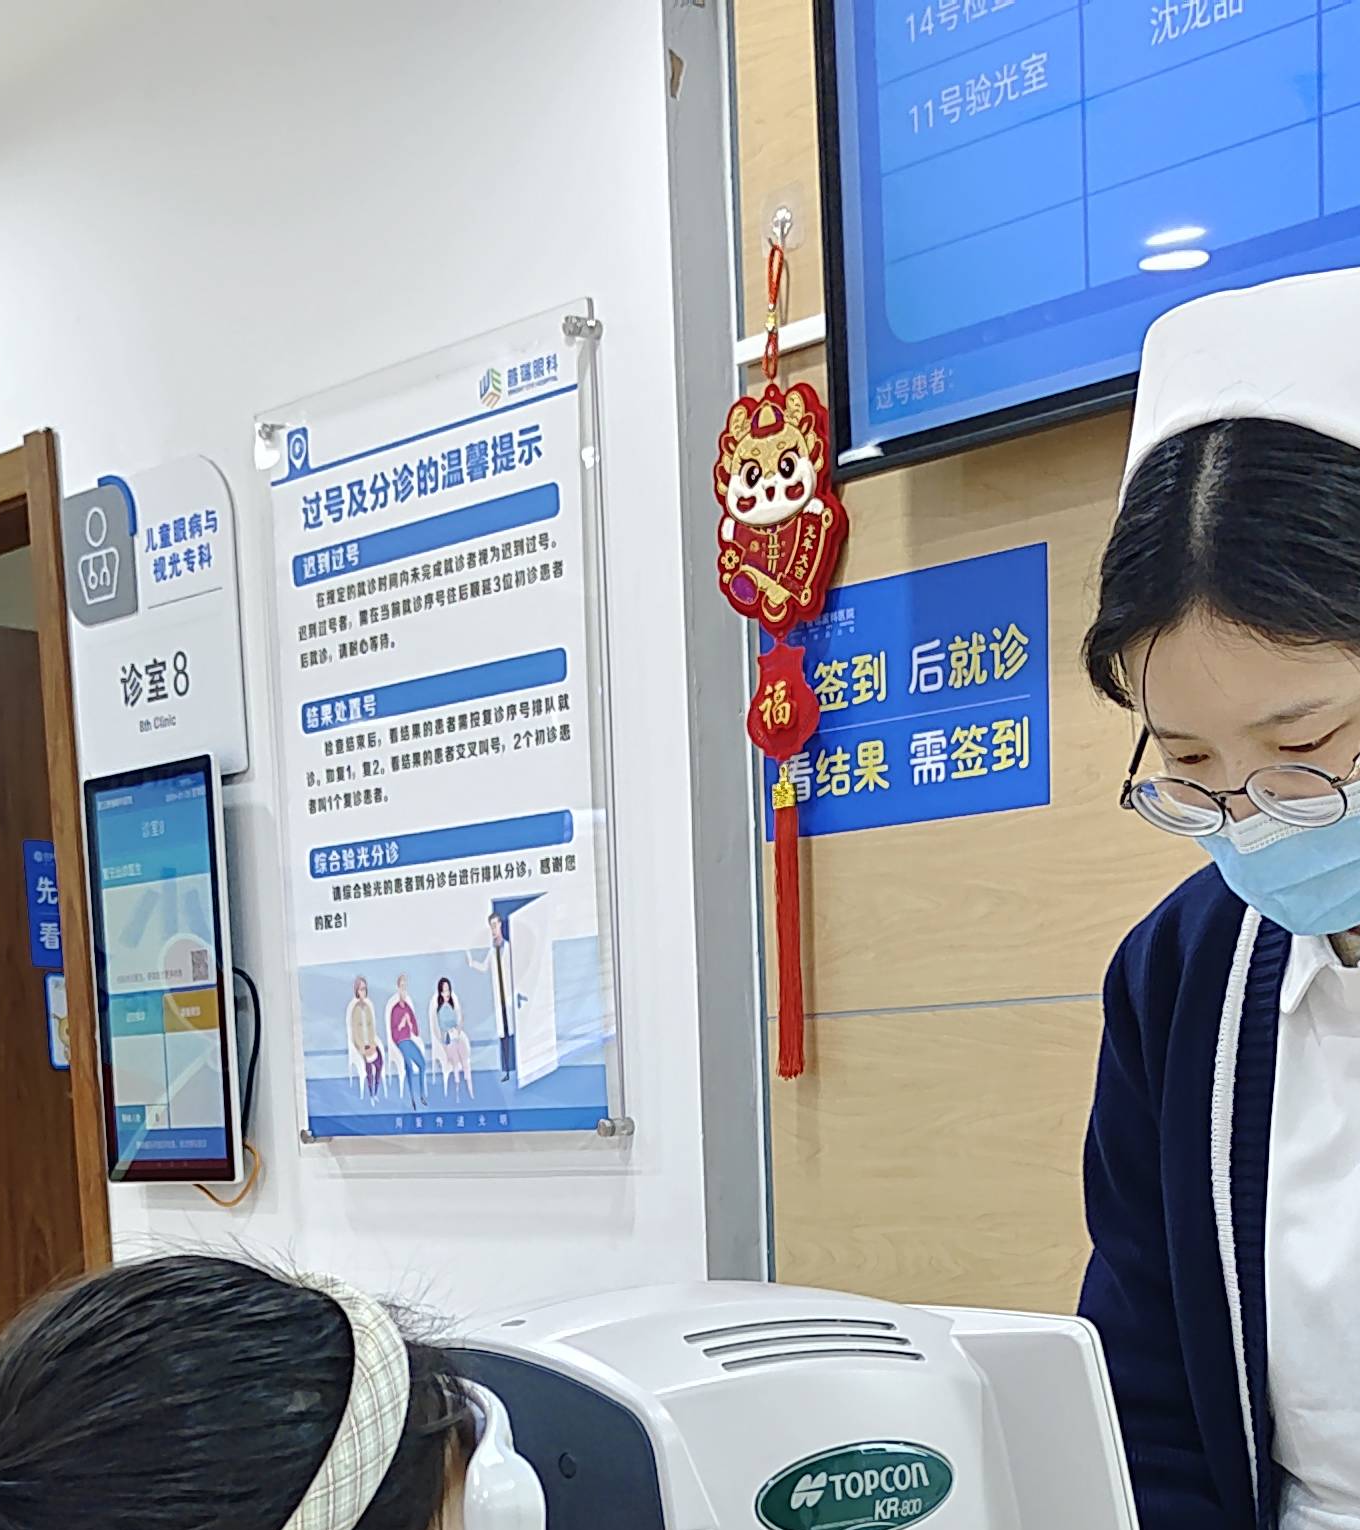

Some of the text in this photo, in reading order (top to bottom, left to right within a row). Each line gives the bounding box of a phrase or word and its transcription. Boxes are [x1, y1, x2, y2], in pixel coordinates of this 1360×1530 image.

[908, 52, 1049, 134] 11号验光室
[301, 424, 544, 532] 过号及分诊的温馨提示
[144, 510, 219, 553] 儿童眼病与
[152, 544, 214, 584] 视光专科
[303, 543, 360, 580] 迟到过号
[907, 623, 1030, 695] 后就诊
[758, 680, 792, 730] 福
[909, 716, 1030, 787] 需签到
[314, 841, 400, 874] 综合验光分诊
[40, 922, 61, 950] 看
[828, 1462, 929, 1501] TOPCON
[874, 1497, 922, 1521] KR-800
